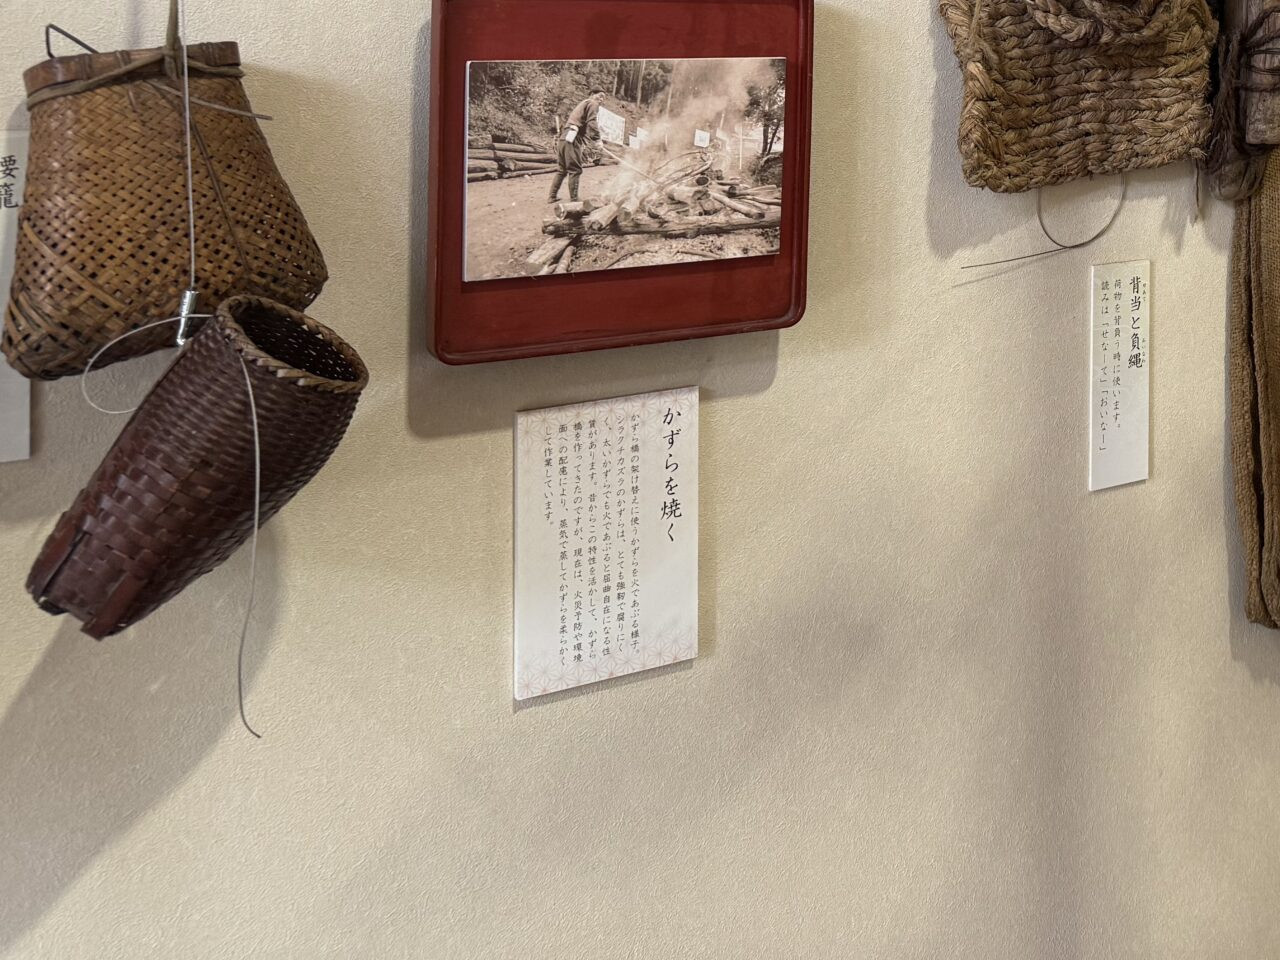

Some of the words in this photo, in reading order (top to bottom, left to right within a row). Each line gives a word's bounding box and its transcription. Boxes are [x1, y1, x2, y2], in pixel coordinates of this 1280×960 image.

[1112, 279, 1122, 429] 荷物を背負う時に使います。
[1127, 276, 1143, 369] 背当と負縄
[543, 426, 555, 527] して作業しています。
[558, 424, 569, 667] 面への配慮により、蒸気で蒸してかずらを柔らかく
[572, 420, 584, 663] 橋を作ってきたのですが、現在は、火災予防や環境
[587, 418, 598, 660] 質があります。昔からこの特性を活かして、かずら
[602, 418, 612, 657] く、太いかずらでも火であぶると屈曲自在になる性
[630, 413, 641, 655] かずら橋の架け替えに使うかずらを火であぶる様子。
[660, 407, 684, 542] かずらを焼く
